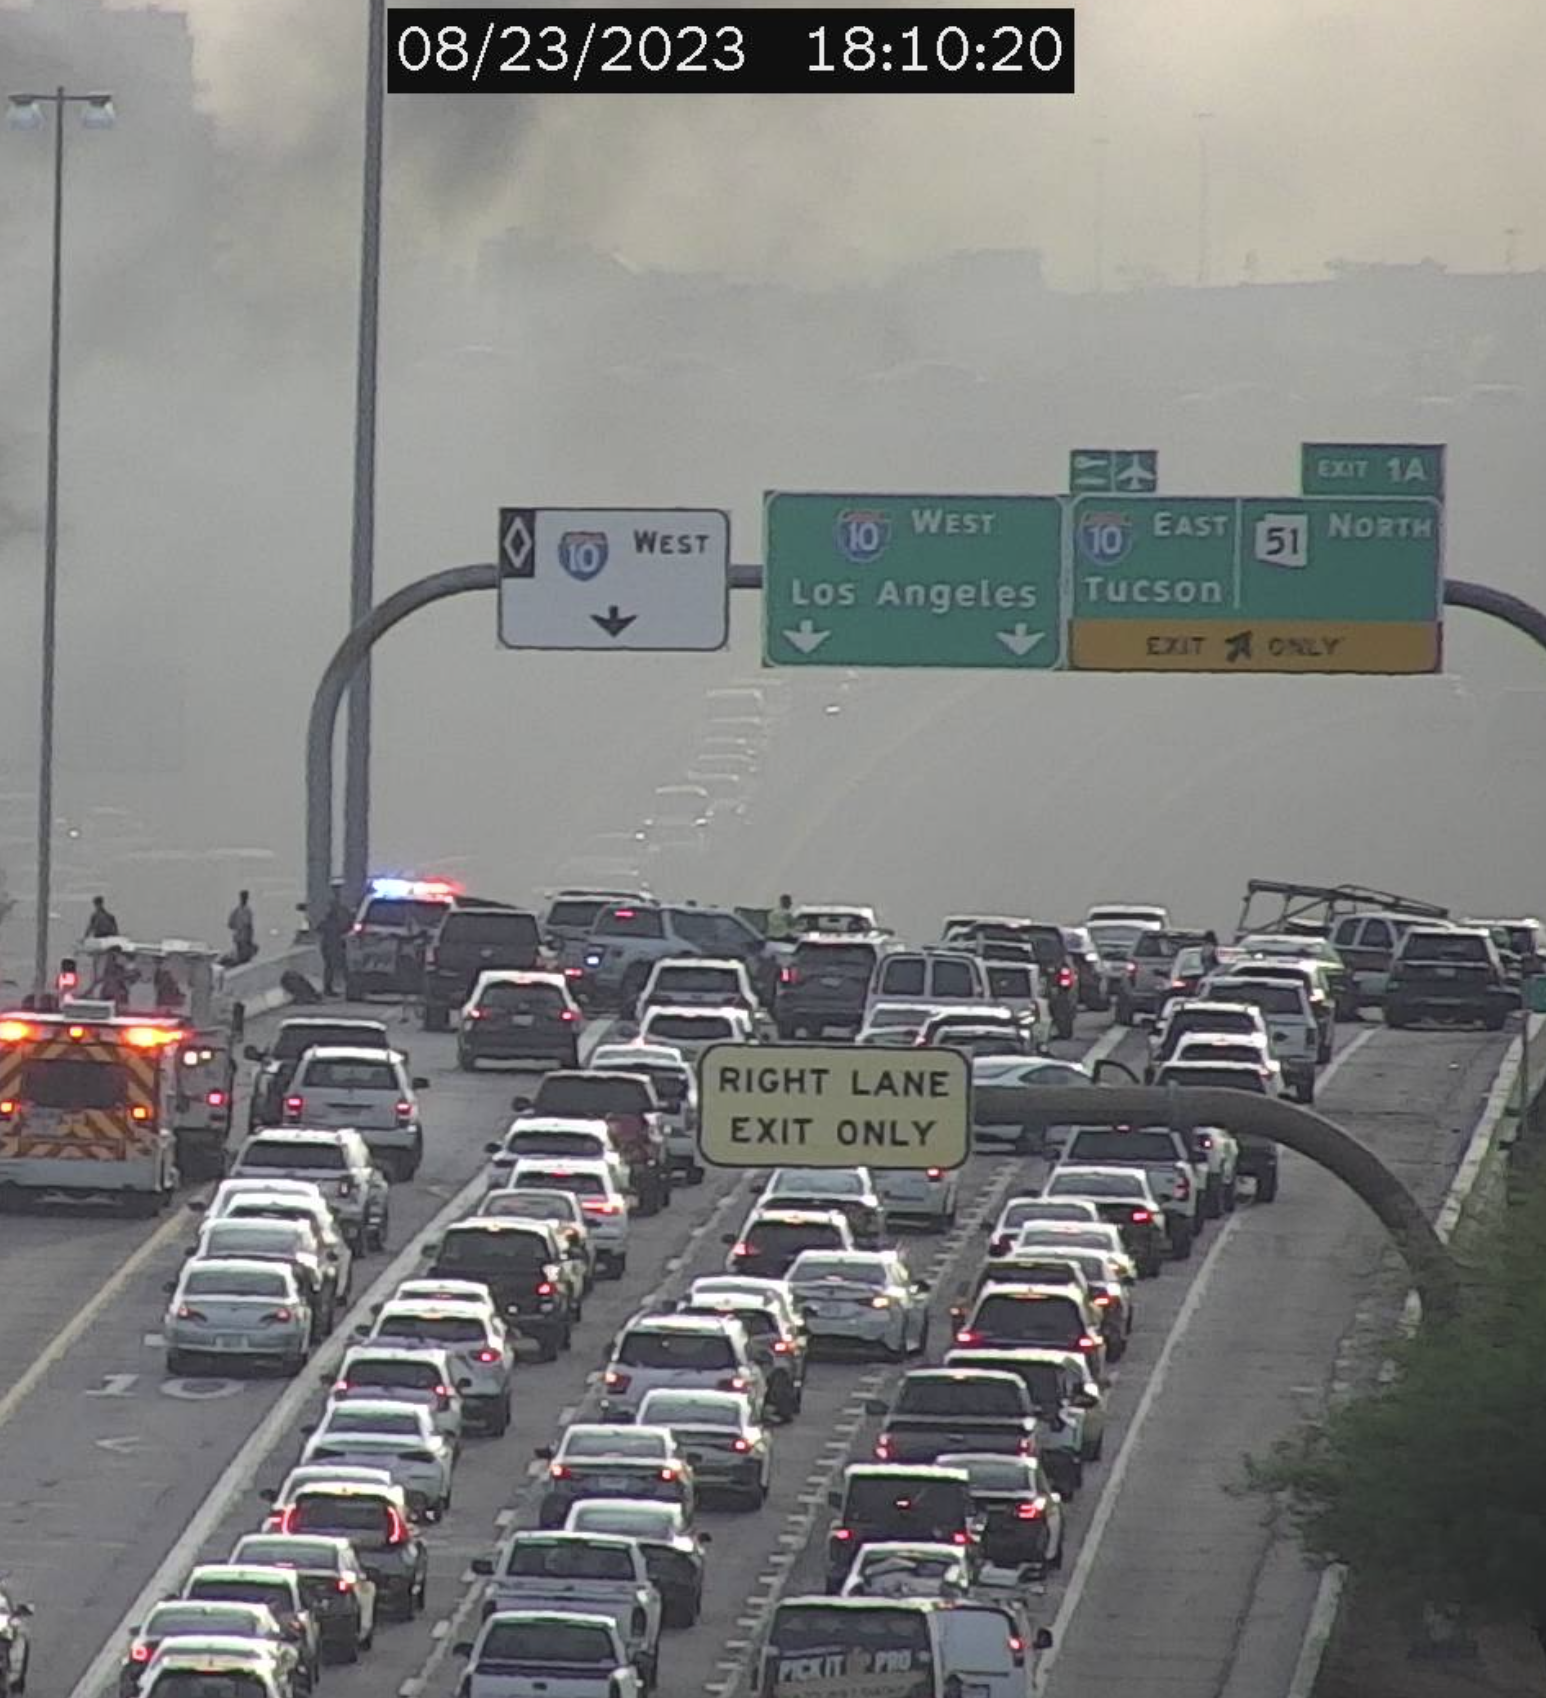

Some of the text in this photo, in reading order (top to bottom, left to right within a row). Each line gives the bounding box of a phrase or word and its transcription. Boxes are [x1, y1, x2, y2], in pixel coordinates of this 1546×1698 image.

[1317, 456, 1428, 482] EXIT 1A
[846, 508, 996, 551] 10 WEST
[1088, 511, 1229, 555] 10 EAST
[1265, 511, 1433, 557] 51 NORTH
[568, 529, 709, 574] 10 WEST
[791, 579, 1037, 614] Los Angeles
[1083, 575, 1222, 604] Tucson
[1147, 635, 1344, 657] EXIT ONLY
[719, 1066, 950, 1098] RIGHT LANE
[731, 1116, 937, 1147] EXIT ONLY
